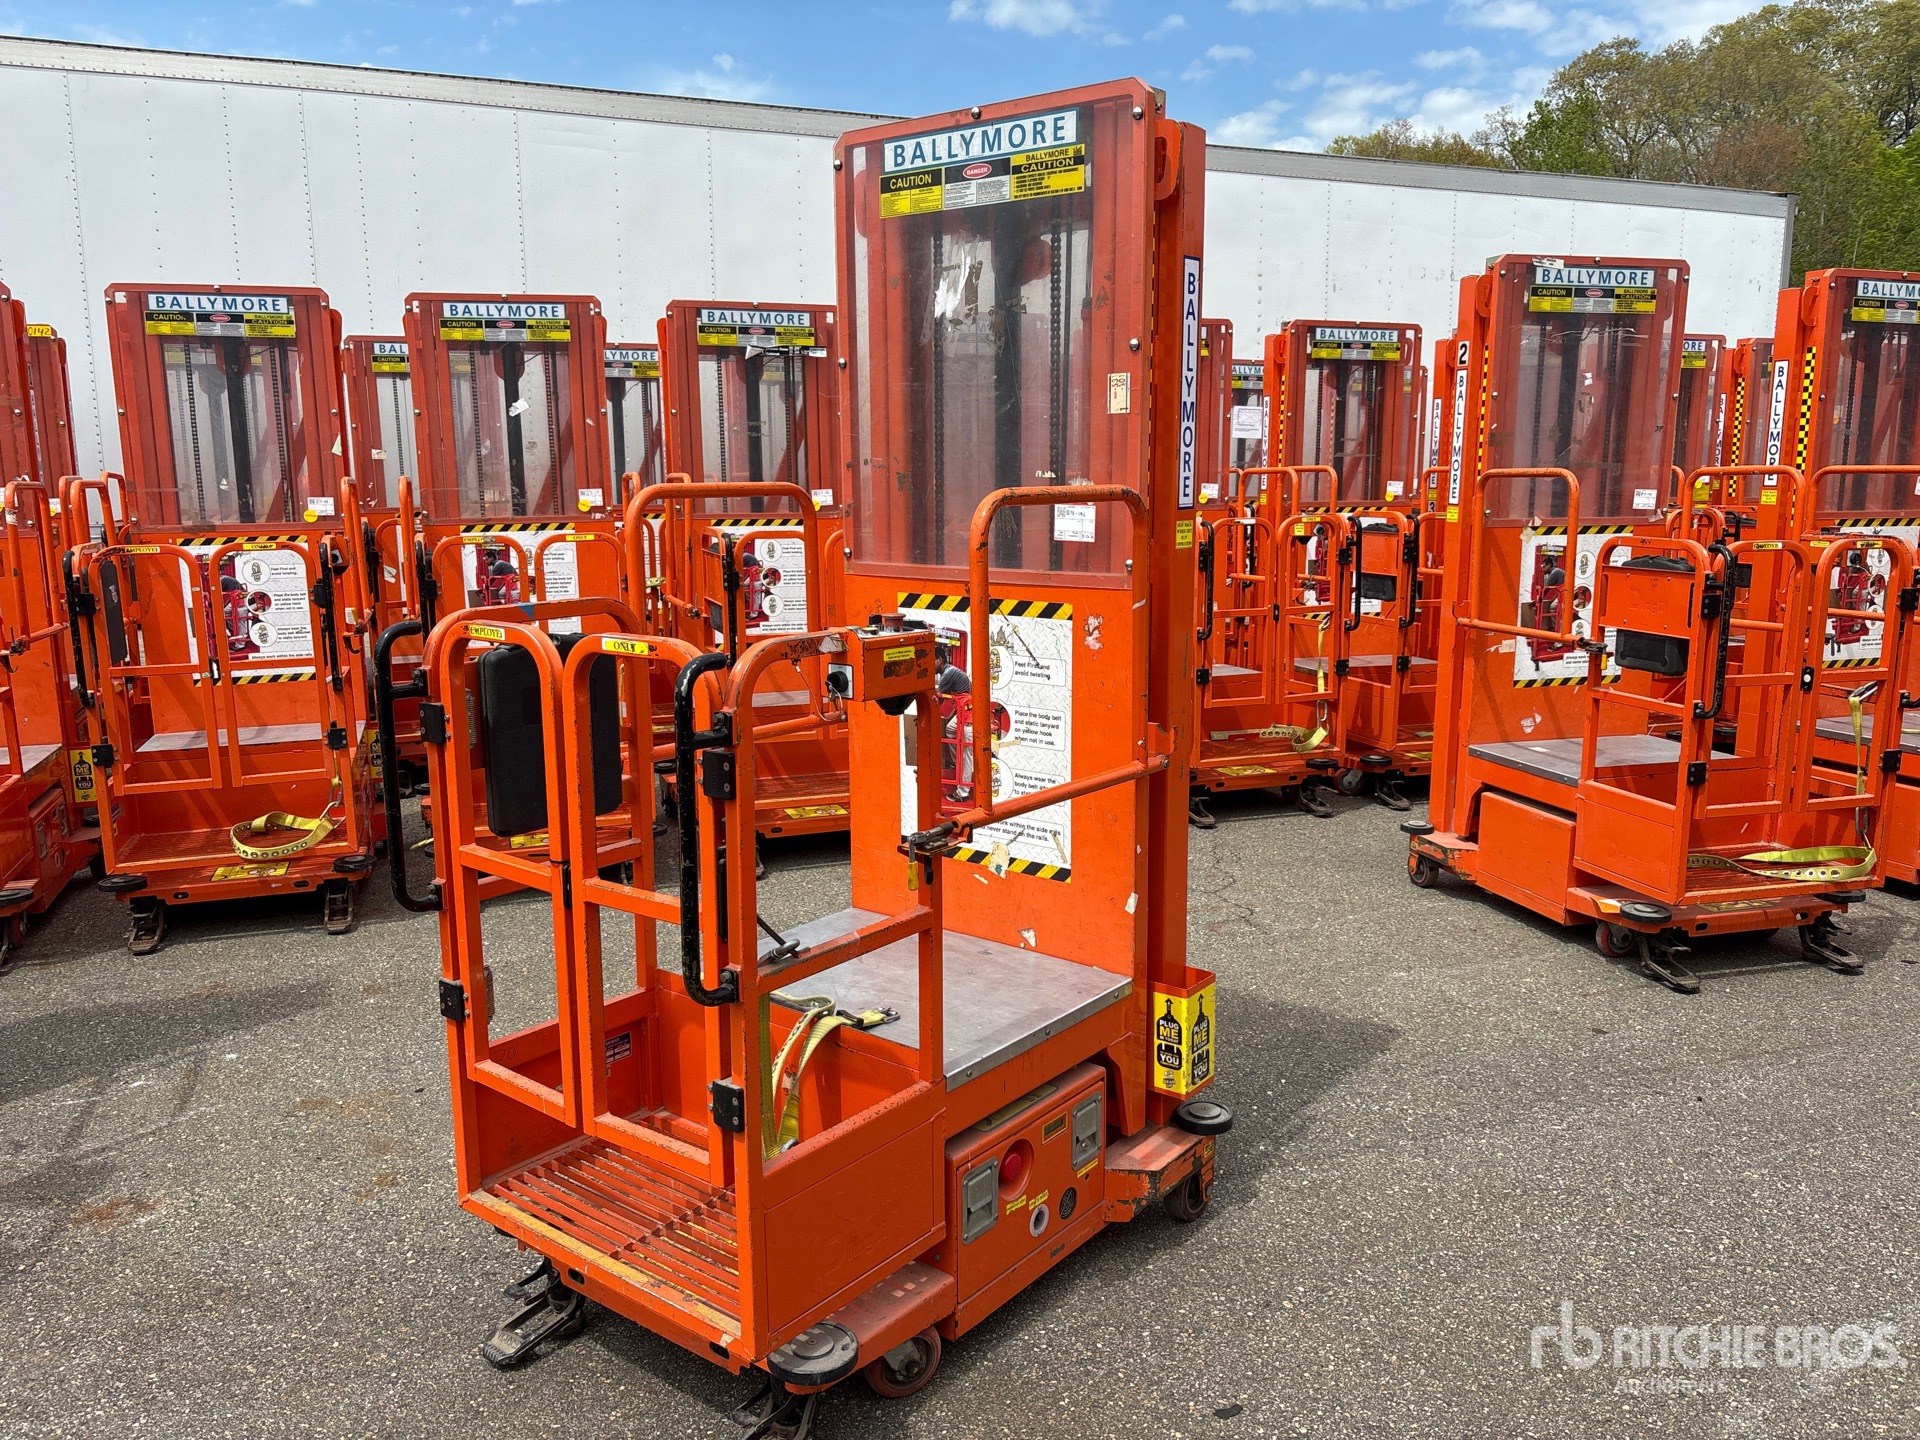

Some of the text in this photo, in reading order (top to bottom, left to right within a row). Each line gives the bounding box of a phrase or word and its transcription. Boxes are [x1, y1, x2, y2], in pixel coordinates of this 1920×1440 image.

[893, 116, 1066, 168] BALLYMORE
[1025, 148, 1070, 163] BALLYMORE
[966, 166, 988, 176] DANGER
[1020, 157, 1074, 173] CAUTION
[890, 173, 932, 190] CAUTION
[1542, 268, 1649, 286] BALLYMORE
[1537, 288, 1567, 296] CAUTION
[1862, 282, 1920, 298] BALLYM
[155, 295, 281, 311] BALLYMORE
[449, 304, 560, 318] BALLYMORE
[707, 311, 806, 326] BALLYMORE
[704, 326, 731, 334] CAUTION
[1319, 330, 1395, 341] BALLYMORE
[604, 351, 656, 361] LYMORE
[1458, 343, 1468, 365] 2
[1182, 271, 1197, 498] BALLYMORE
[1451, 375, 1465, 499] BALLYMORE
[613, 640, 637, 653] ONLY
[1038, 713, 1051, 721] body
[1022, 727, 1038, 735] yellow
[1025, 719, 1039, 727] static
[1040, 721, 1060, 730] lanyard
[1014, 772, 1033, 781] Always
[1014, 780, 1027, 789] body
[1009, 820, 1026, 829] within
[1002, 828, 1017, 836] stand
[1159, 1019, 1179, 1030] PLUG
[1193, 1018, 1208, 1035] PLUG
[1159, 1026, 1179, 1040] ME
[1193, 1028, 1208, 1046] ME
[1160, 1053, 1180, 1065] YOU
[1193, 1062, 1208, 1078] YOU
